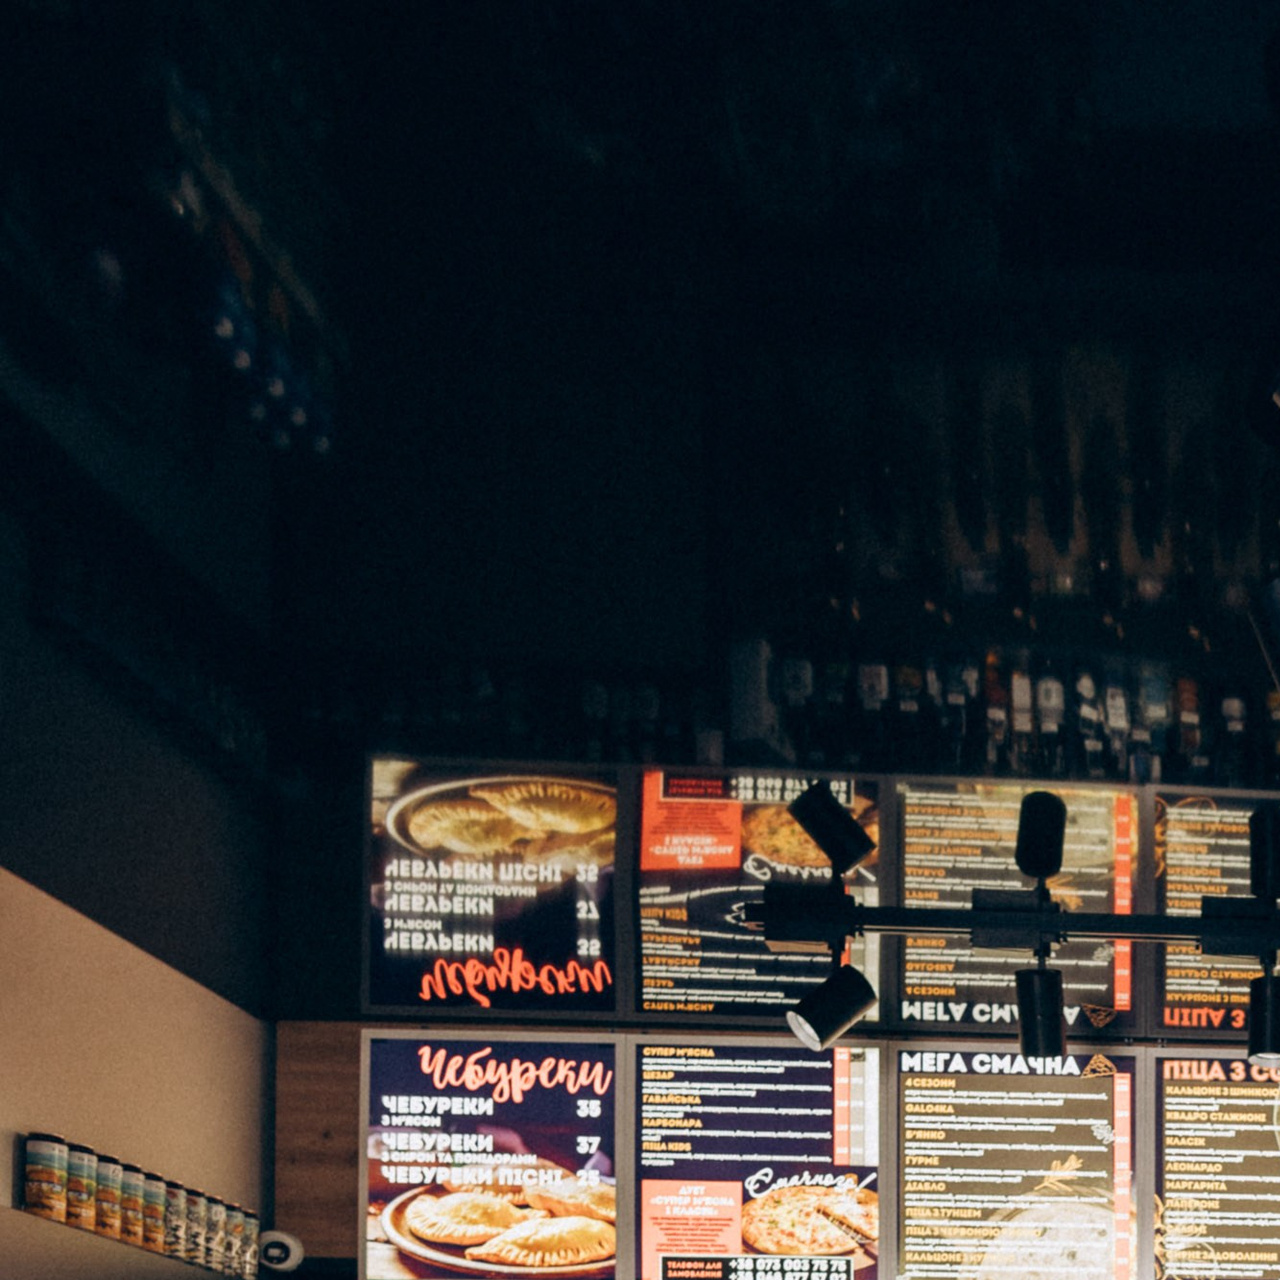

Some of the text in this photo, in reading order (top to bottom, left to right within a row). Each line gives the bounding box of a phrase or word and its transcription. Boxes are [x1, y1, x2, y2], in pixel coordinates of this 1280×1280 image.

[418, 1045, 613, 1103] Чебуреки
[901, 1052, 1081, 1076] МЕГА СМАЧНА
[1163, 1060, 1227, 1082] ПІЦА
[381, 1095, 601, 1118] ЧЕБУРЕКИ 35
[381, 1132, 601, 1154] ЧЕБУРЕКИ 37
[380, 1166, 494, 1185] ЧЕБУРЕКИ
[500, 1168, 563, 1186] ПІСНІ
